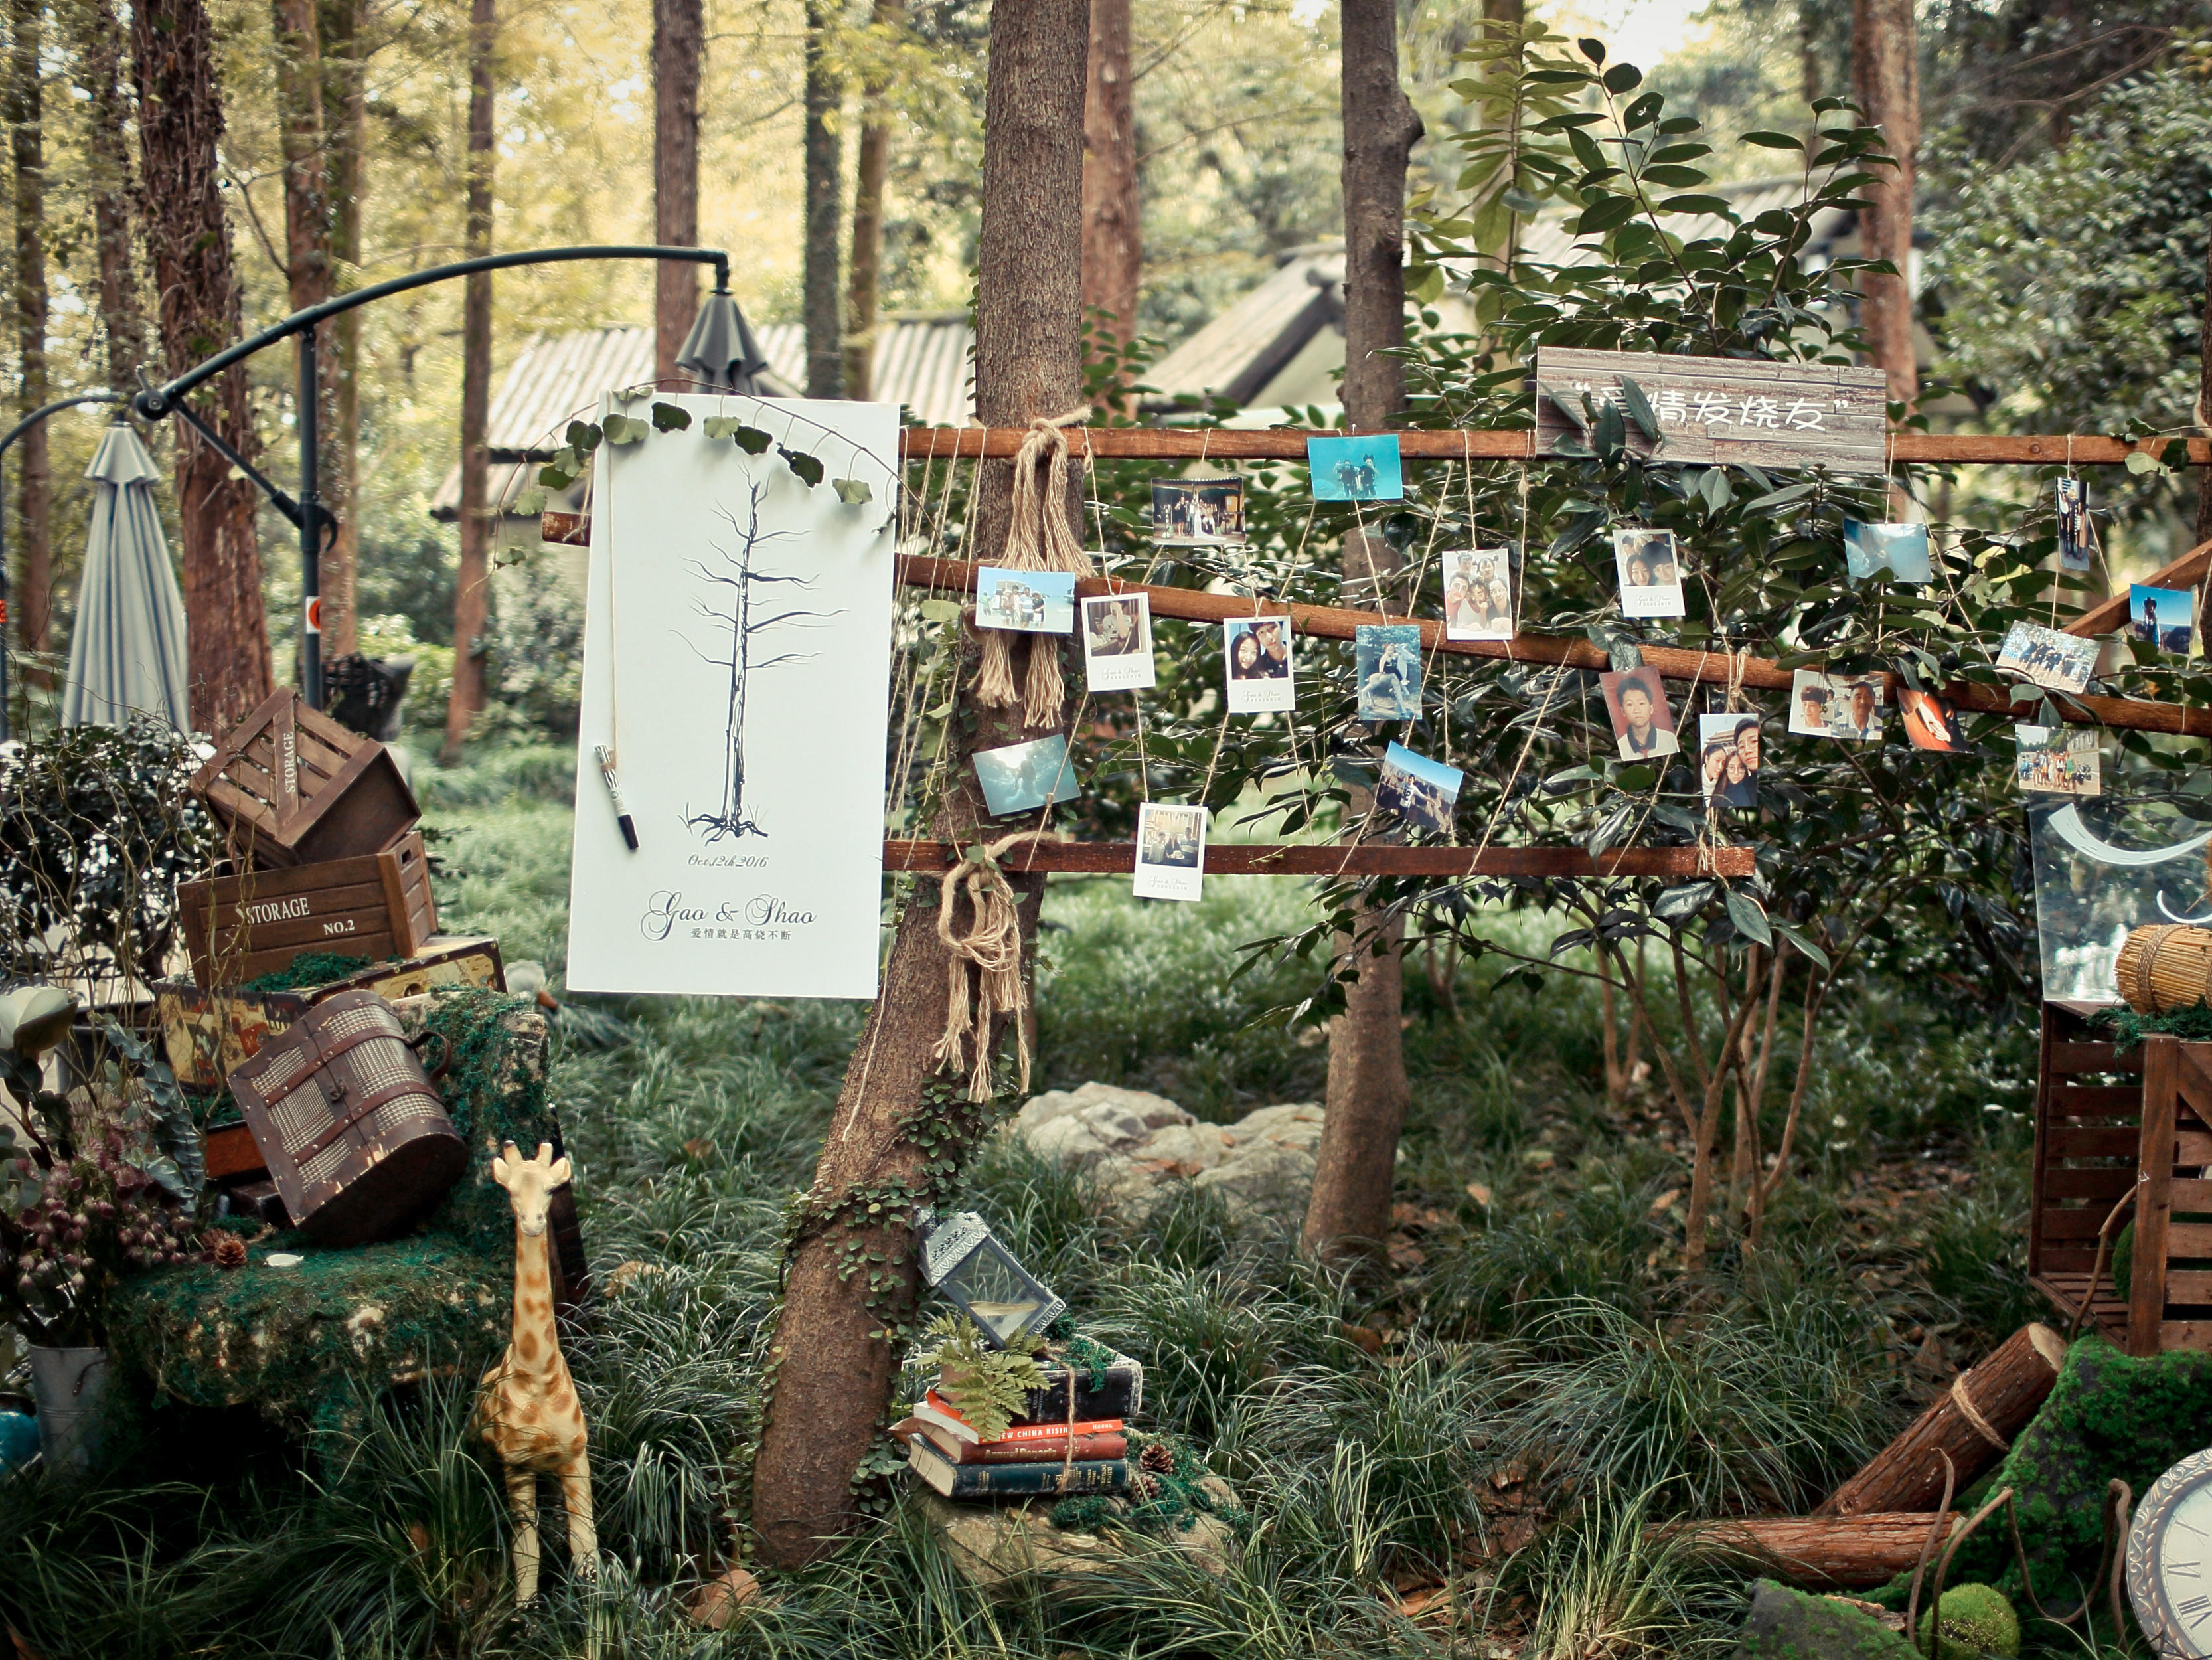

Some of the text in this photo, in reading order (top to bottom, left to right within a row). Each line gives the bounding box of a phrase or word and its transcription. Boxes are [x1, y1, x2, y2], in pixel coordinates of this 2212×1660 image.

[284, 732, 296, 794] STORAGE
[246, 898, 310, 924] STORAGE
[641, 890, 818, 942] Gao & Shao
[323, 920, 355, 936] NO.2
[690, 927, 791, 940] 爱情就是高烧不断
[1017, 1429, 1043, 1438] CHINA
[1046, 1426, 1068, 1435] RISIN
